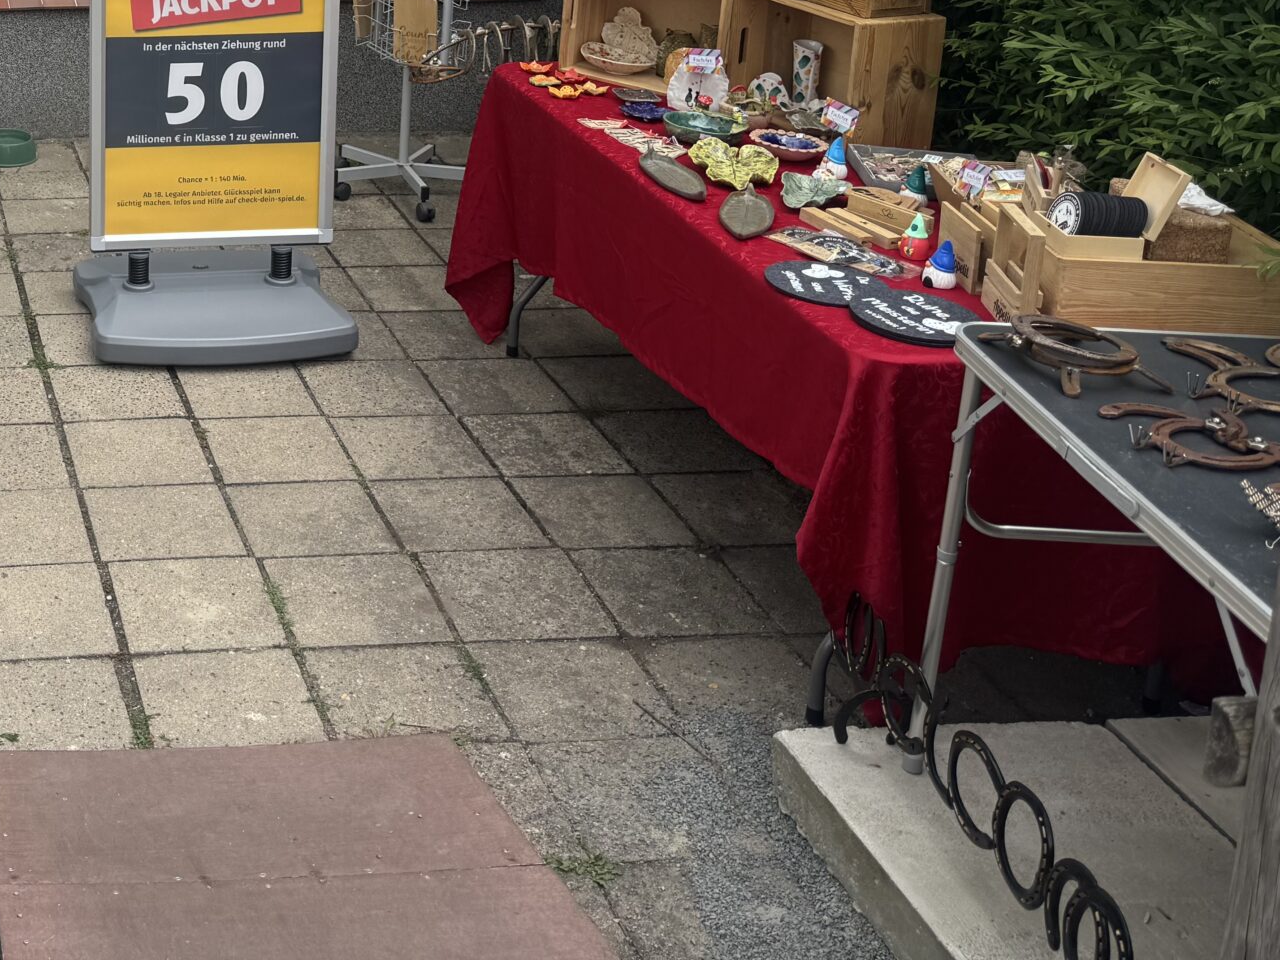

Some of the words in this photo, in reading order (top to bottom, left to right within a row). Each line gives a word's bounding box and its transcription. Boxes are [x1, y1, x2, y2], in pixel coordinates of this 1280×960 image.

[143, 42, 153, 51] In
[155, 42, 171, 51] der
[174, 41, 219, 51] nächsten
[221, 39, 261, 51] Ziehung
[263, 39, 286, 49] rund
[165, 60, 264, 125] 50
[126, 134, 172, 144] Millionen
[174, 134, 181, 142] €
[183, 133, 193, 142] in
[195, 132, 227, 142] Klasse
[229, 133, 234, 141] 1
[249, 131, 299, 142] gewinnen.
[165, 191, 190, 199] Legaler
[223, 188, 263, 198] Glücksspiel
[264, 187, 281, 195] kann
[117, 200, 142, 208] süchtig
[207, 197, 224, 205] Hilfe
[225, 196, 237, 204] auf
